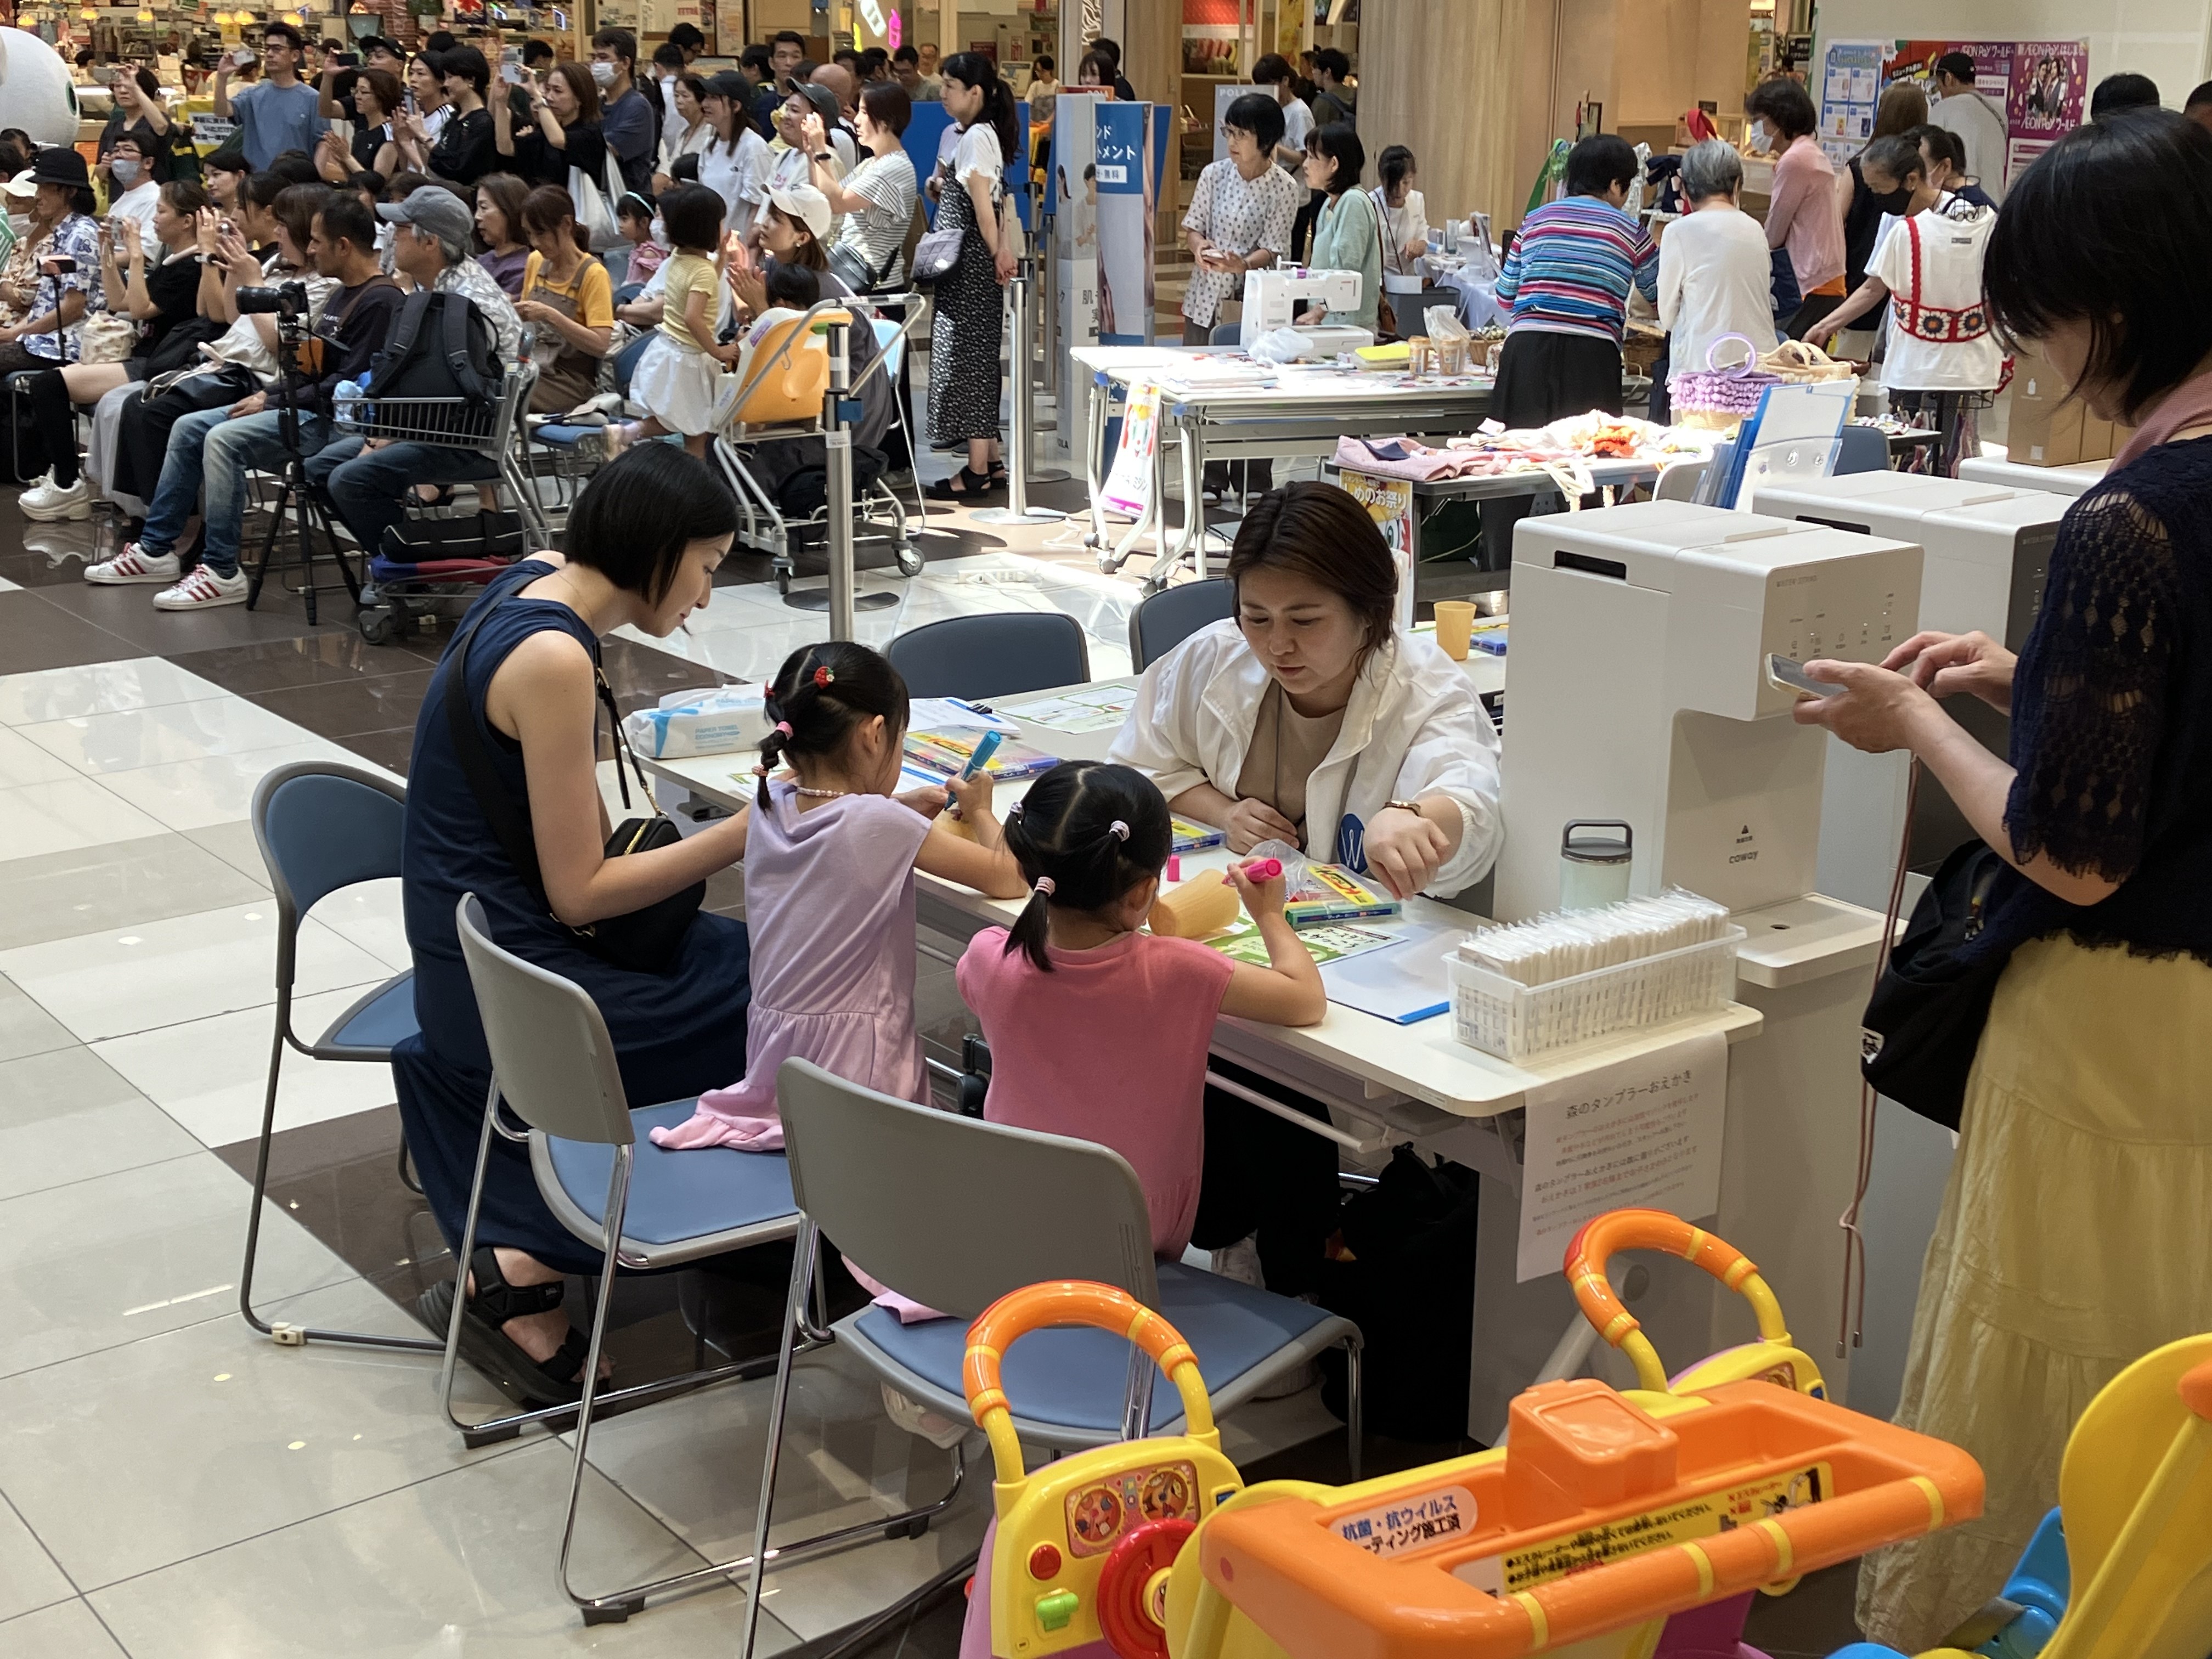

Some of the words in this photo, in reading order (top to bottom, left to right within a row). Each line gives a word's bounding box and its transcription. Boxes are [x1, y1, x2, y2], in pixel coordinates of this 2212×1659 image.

[1220, 88, 1248, 97] POLA
[1340, 827, 1364, 869] W
[1729, 850, 1759, 864] coway
[1342, 1494, 1457, 1540] 抗菌・抗ウイルス
